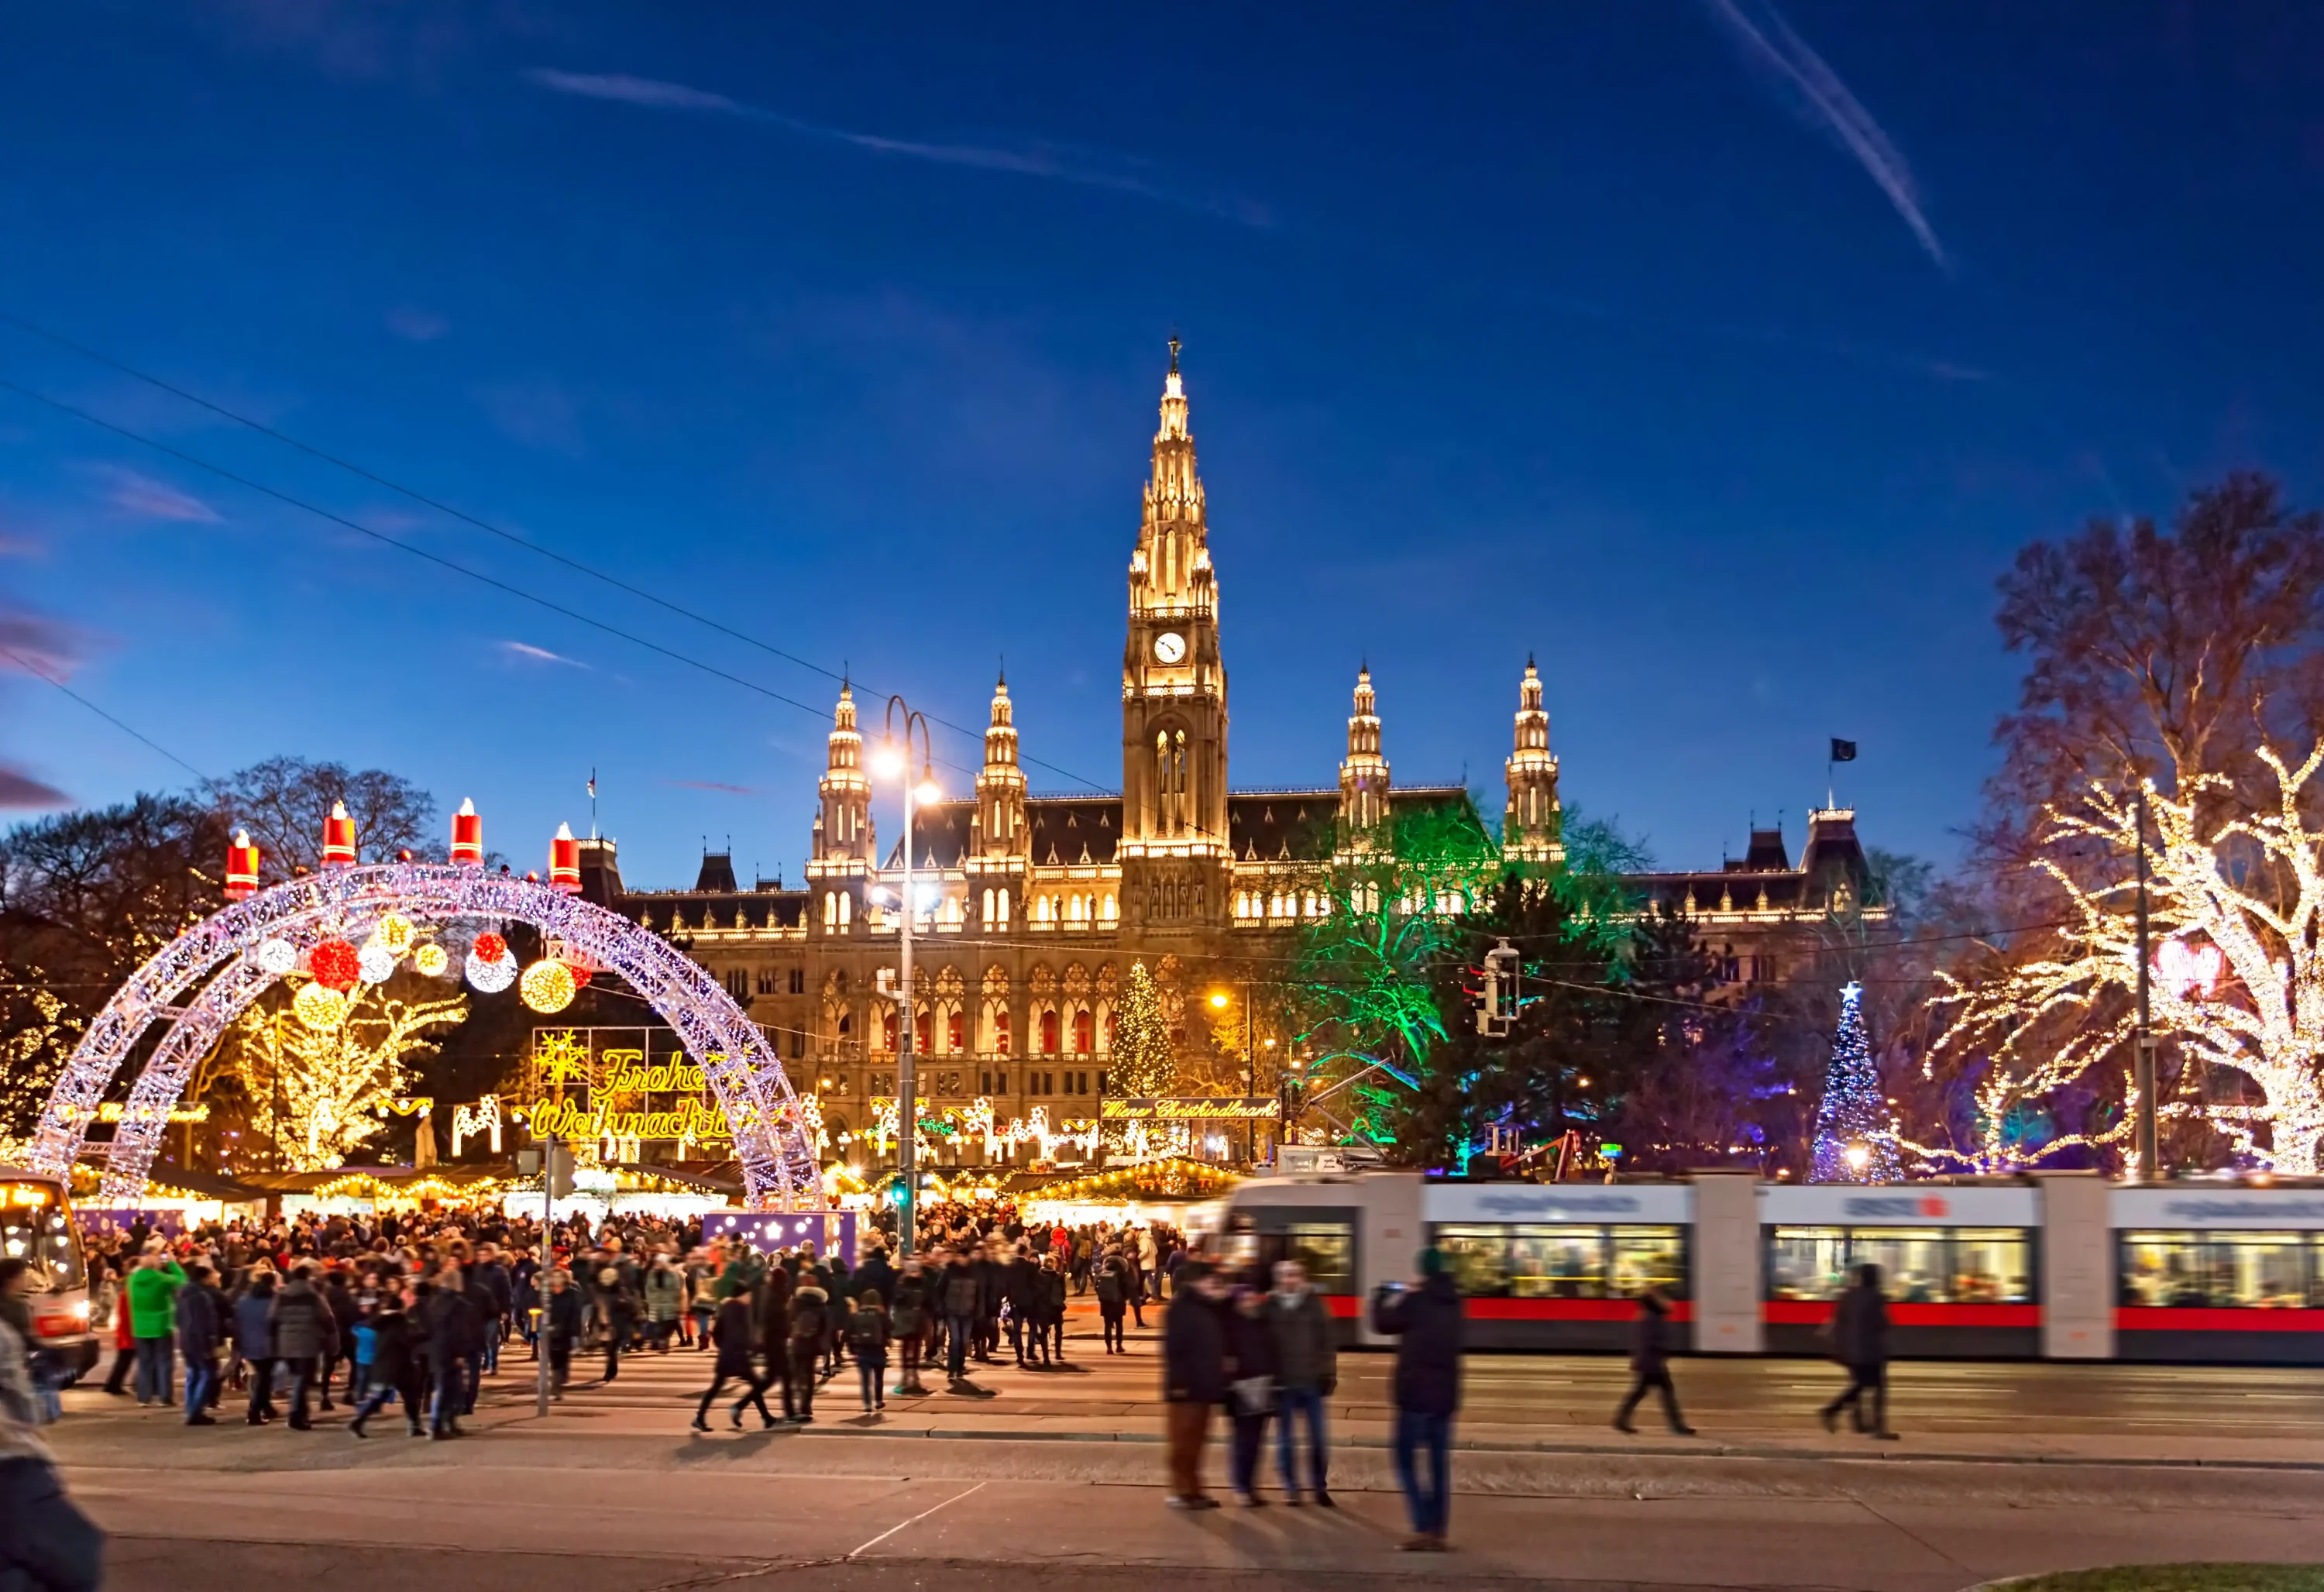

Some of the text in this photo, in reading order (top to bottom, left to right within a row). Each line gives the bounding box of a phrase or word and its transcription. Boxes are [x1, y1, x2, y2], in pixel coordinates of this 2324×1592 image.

[590, 1048, 706, 1099] Frohe
[530, 1097, 759, 1139] Weihnacht
[1102, 1099, 1281, 1118] Wiener Christkindlmarkt
